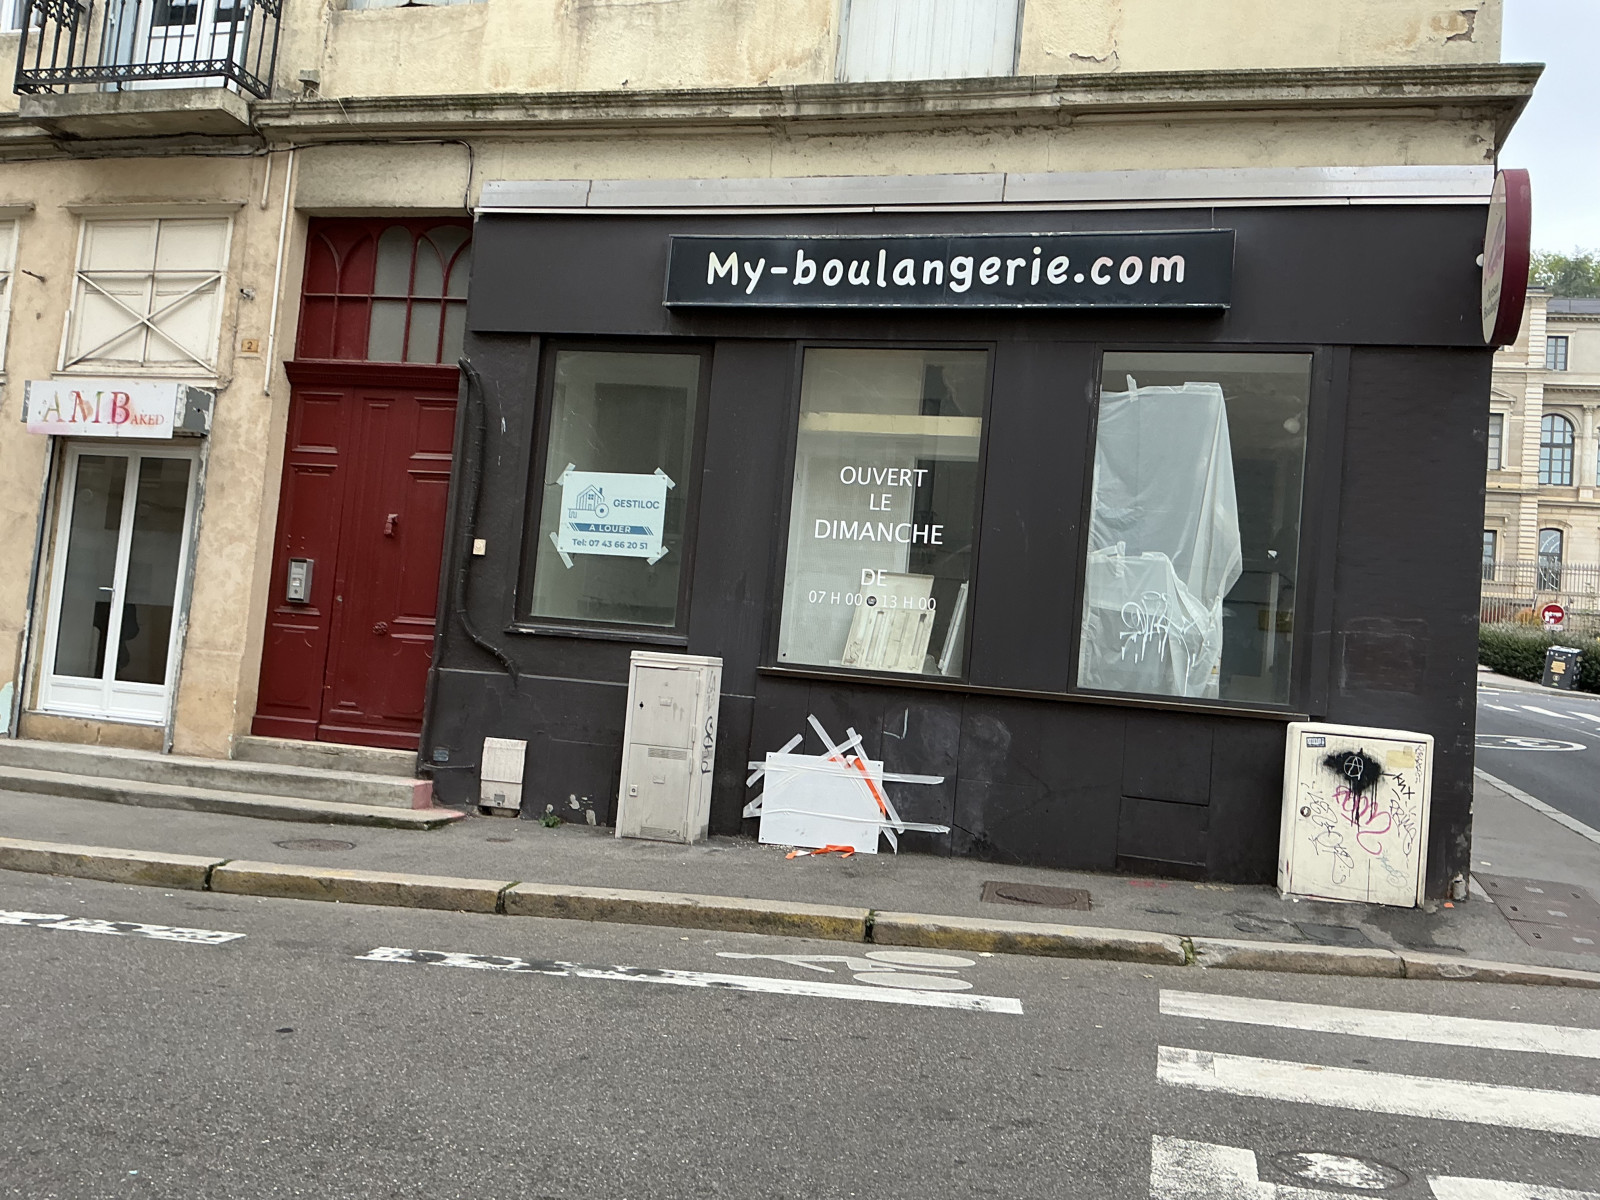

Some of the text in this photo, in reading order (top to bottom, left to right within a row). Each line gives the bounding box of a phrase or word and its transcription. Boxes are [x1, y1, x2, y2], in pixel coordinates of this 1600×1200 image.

[706, 246, 1187, 295] My-boulangerie.com
[246, 341, 254, 351] 2
[839, 465, 929, 487] OUVERT
[613, 499, 660, 510] GESTILOC
[869, 493, 892, 511] LE
[589, 524, 631, 533] A LOUER
[814, 518, 945, 545] DIMANCHE
[572, 538, 648, 550] Tel: 07 43 66 20 51
[860, 568, 889, 587] DE
[808, 590, 937, 611] 07 H 00 13 H 00
